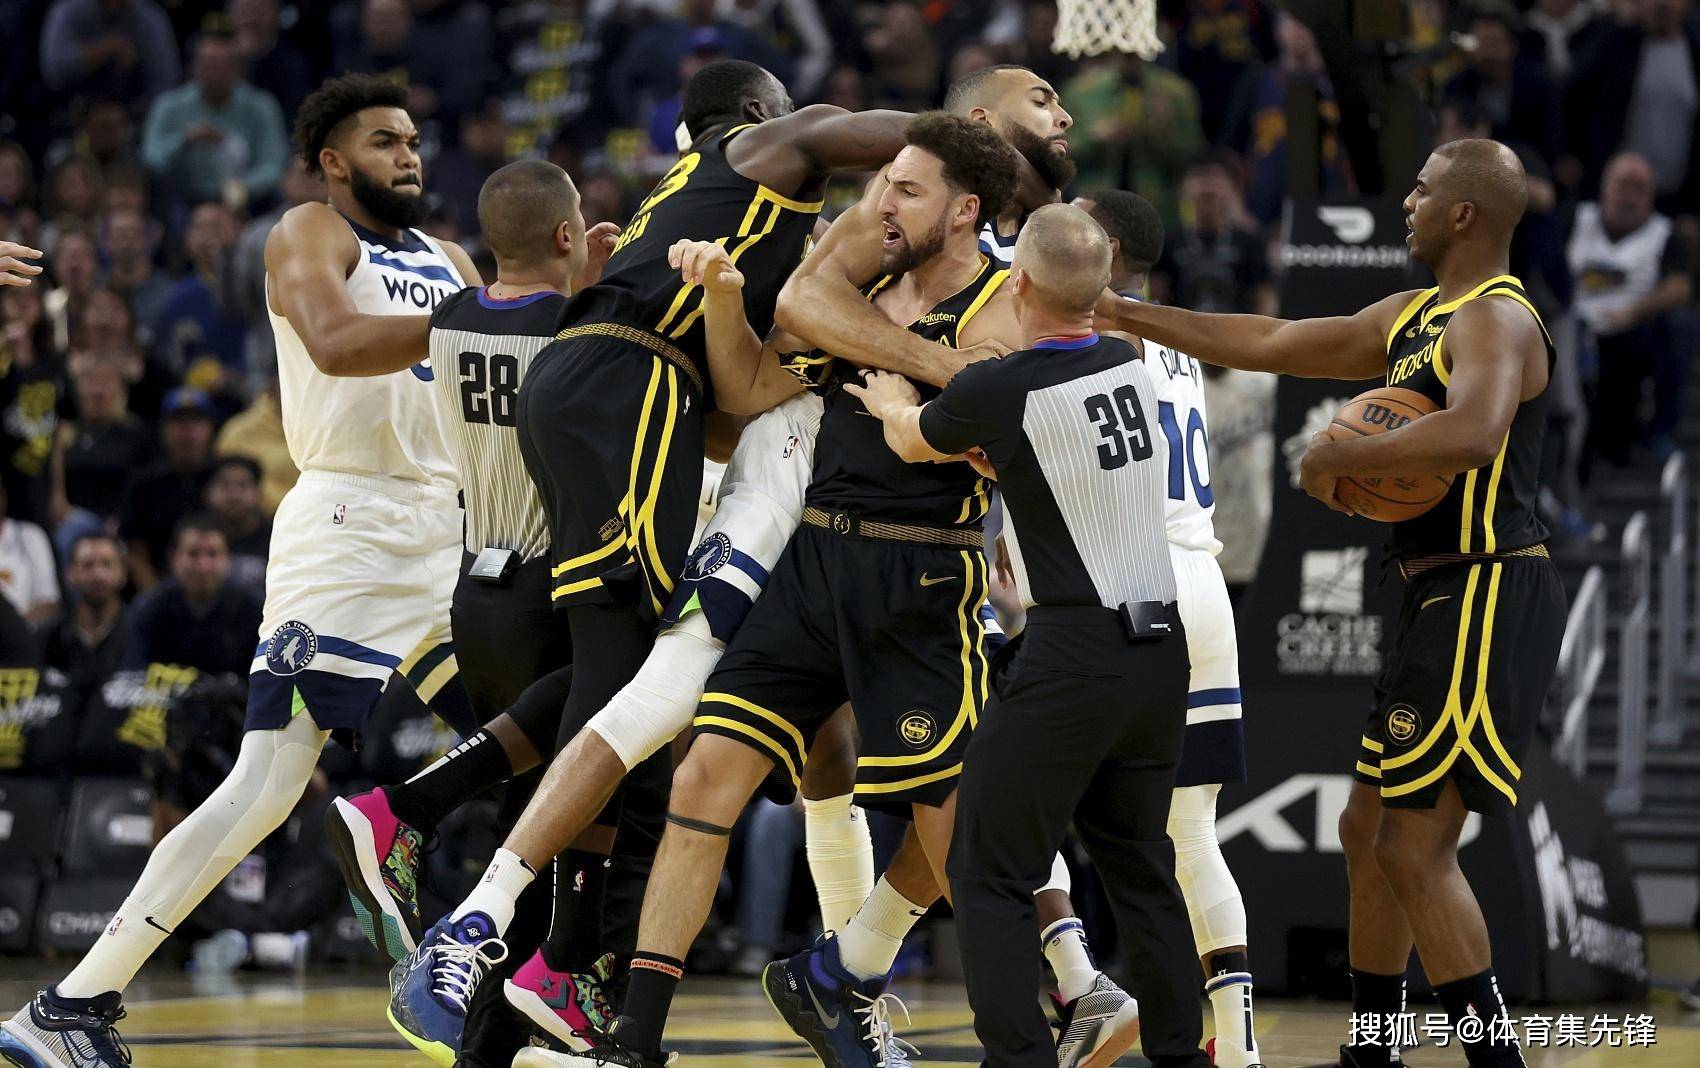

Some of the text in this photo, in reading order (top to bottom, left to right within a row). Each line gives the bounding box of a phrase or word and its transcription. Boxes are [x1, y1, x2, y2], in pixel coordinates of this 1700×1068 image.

[1281, 244, 1408, 268] DOORDASH
[459, 351, 518, 427] 28
[1084, 384, 1154, 470] 39
[1158, 400, 1215, 509] 10
